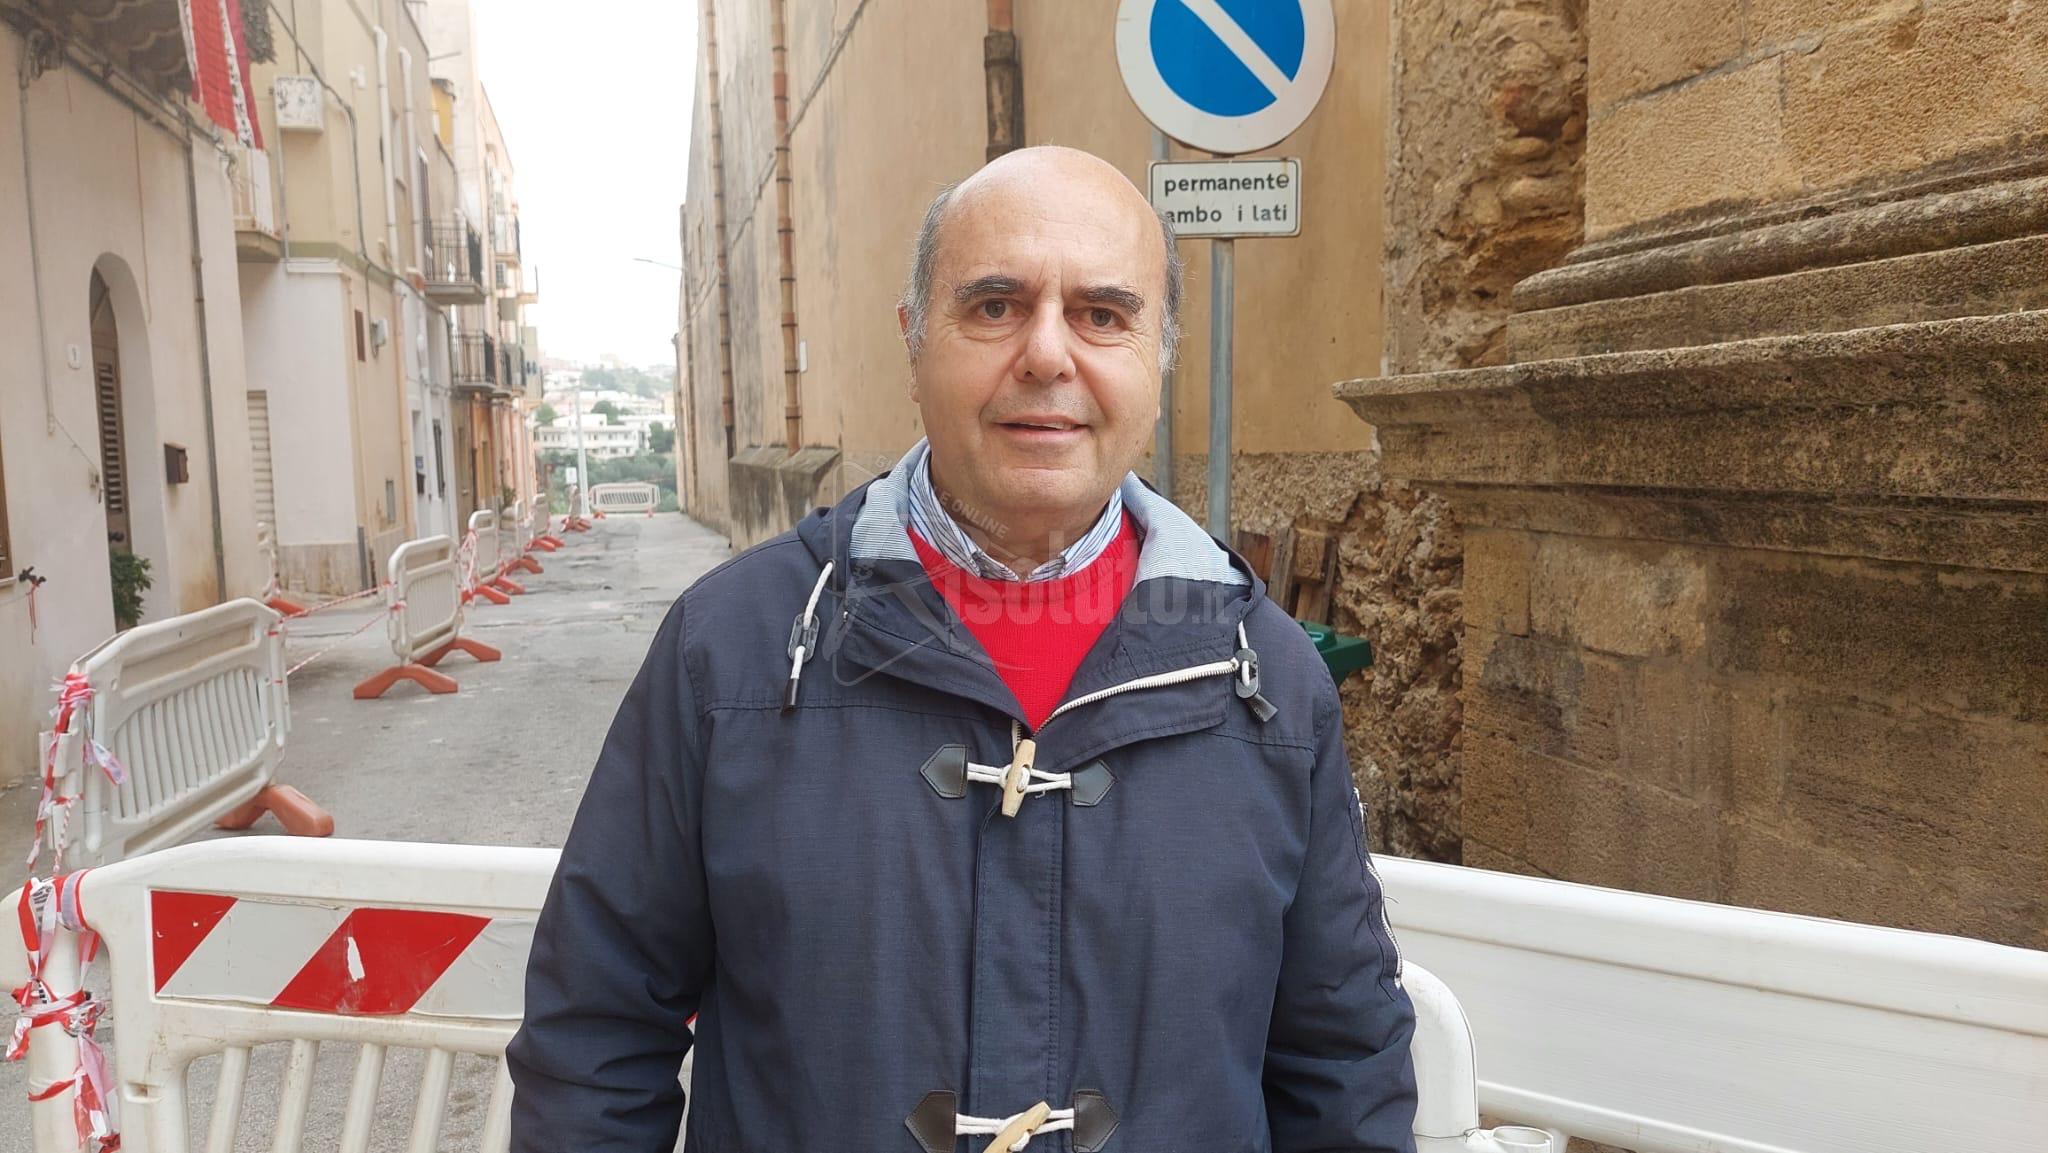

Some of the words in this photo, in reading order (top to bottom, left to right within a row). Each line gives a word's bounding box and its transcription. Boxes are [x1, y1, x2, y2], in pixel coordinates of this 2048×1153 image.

[1164, 173, 1290, 196] permanente
[1166, 205, 1222, 223] ambo
[1237, 204, 1243, 222] i
[1252, 204, 1288, 222] lati
